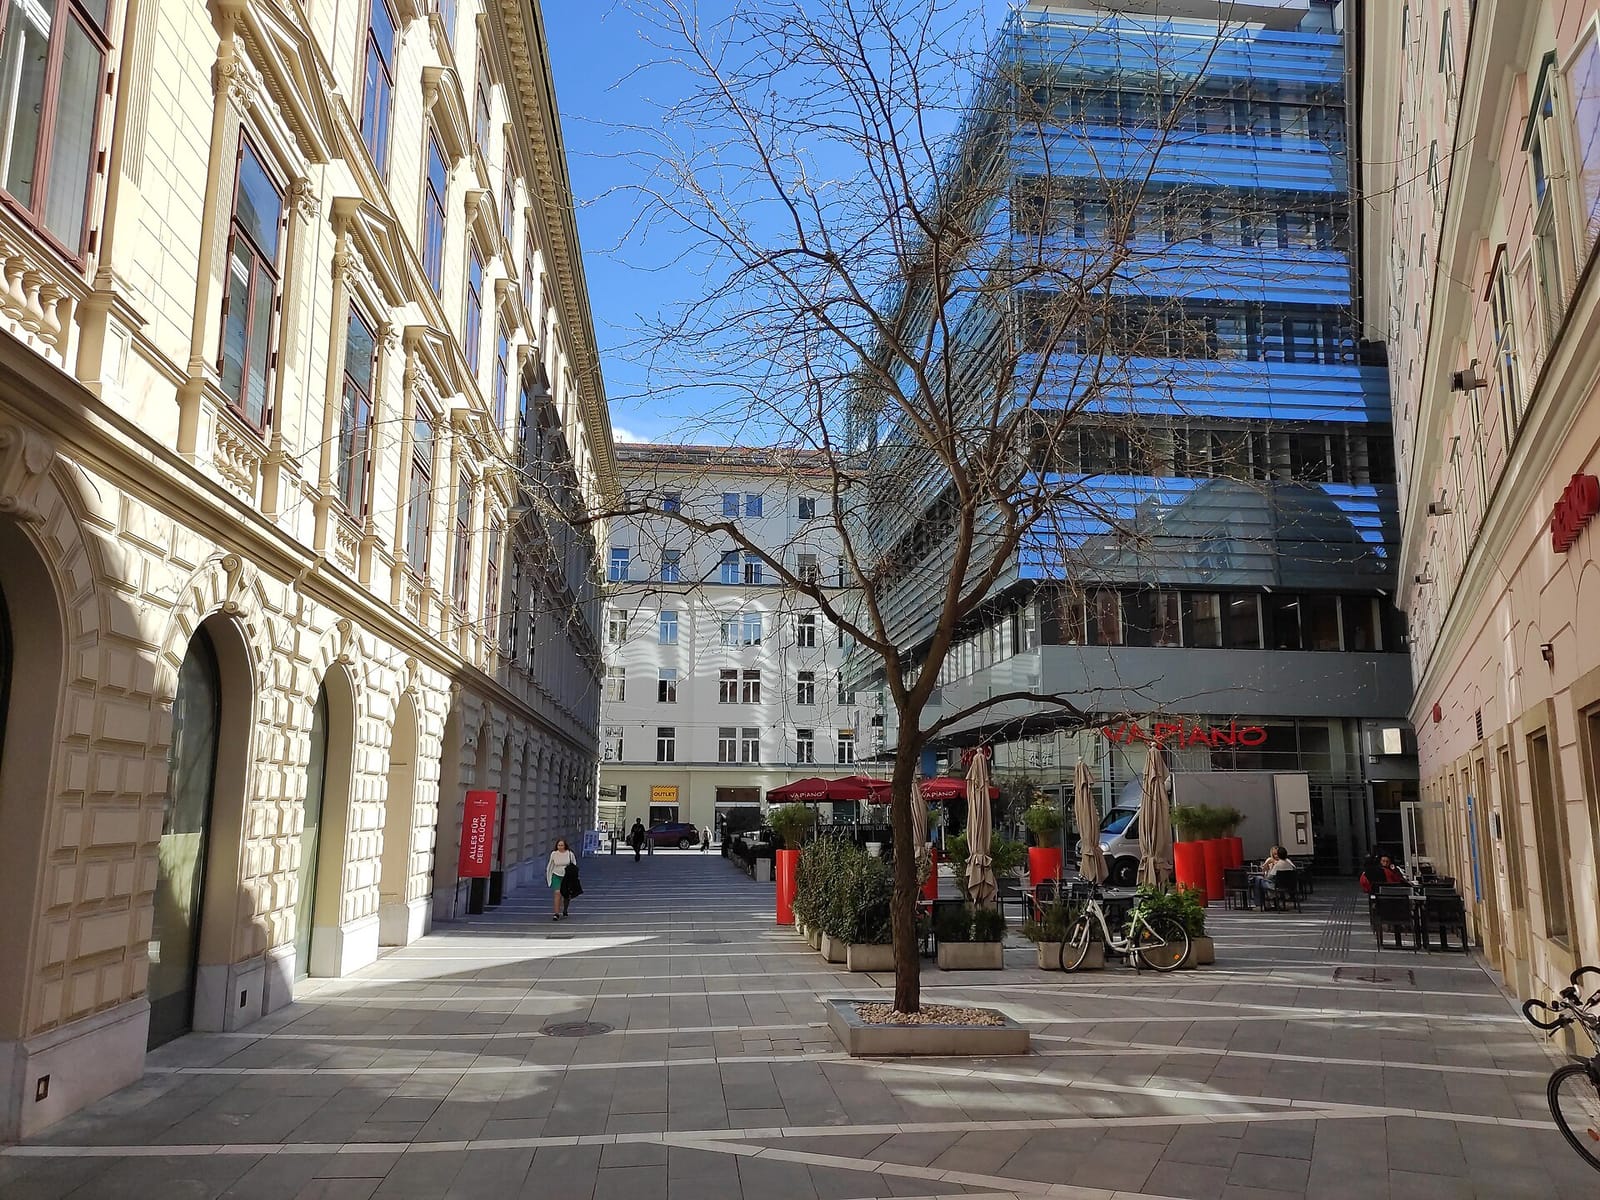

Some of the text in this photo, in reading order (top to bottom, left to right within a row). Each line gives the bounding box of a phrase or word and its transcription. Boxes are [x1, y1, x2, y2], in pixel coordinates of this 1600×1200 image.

[469, 817, 479, 860] ALLES FÜR
[478, 814, 487, 843] GLÜCK!
[476, 845, 484, 864] DEIN
